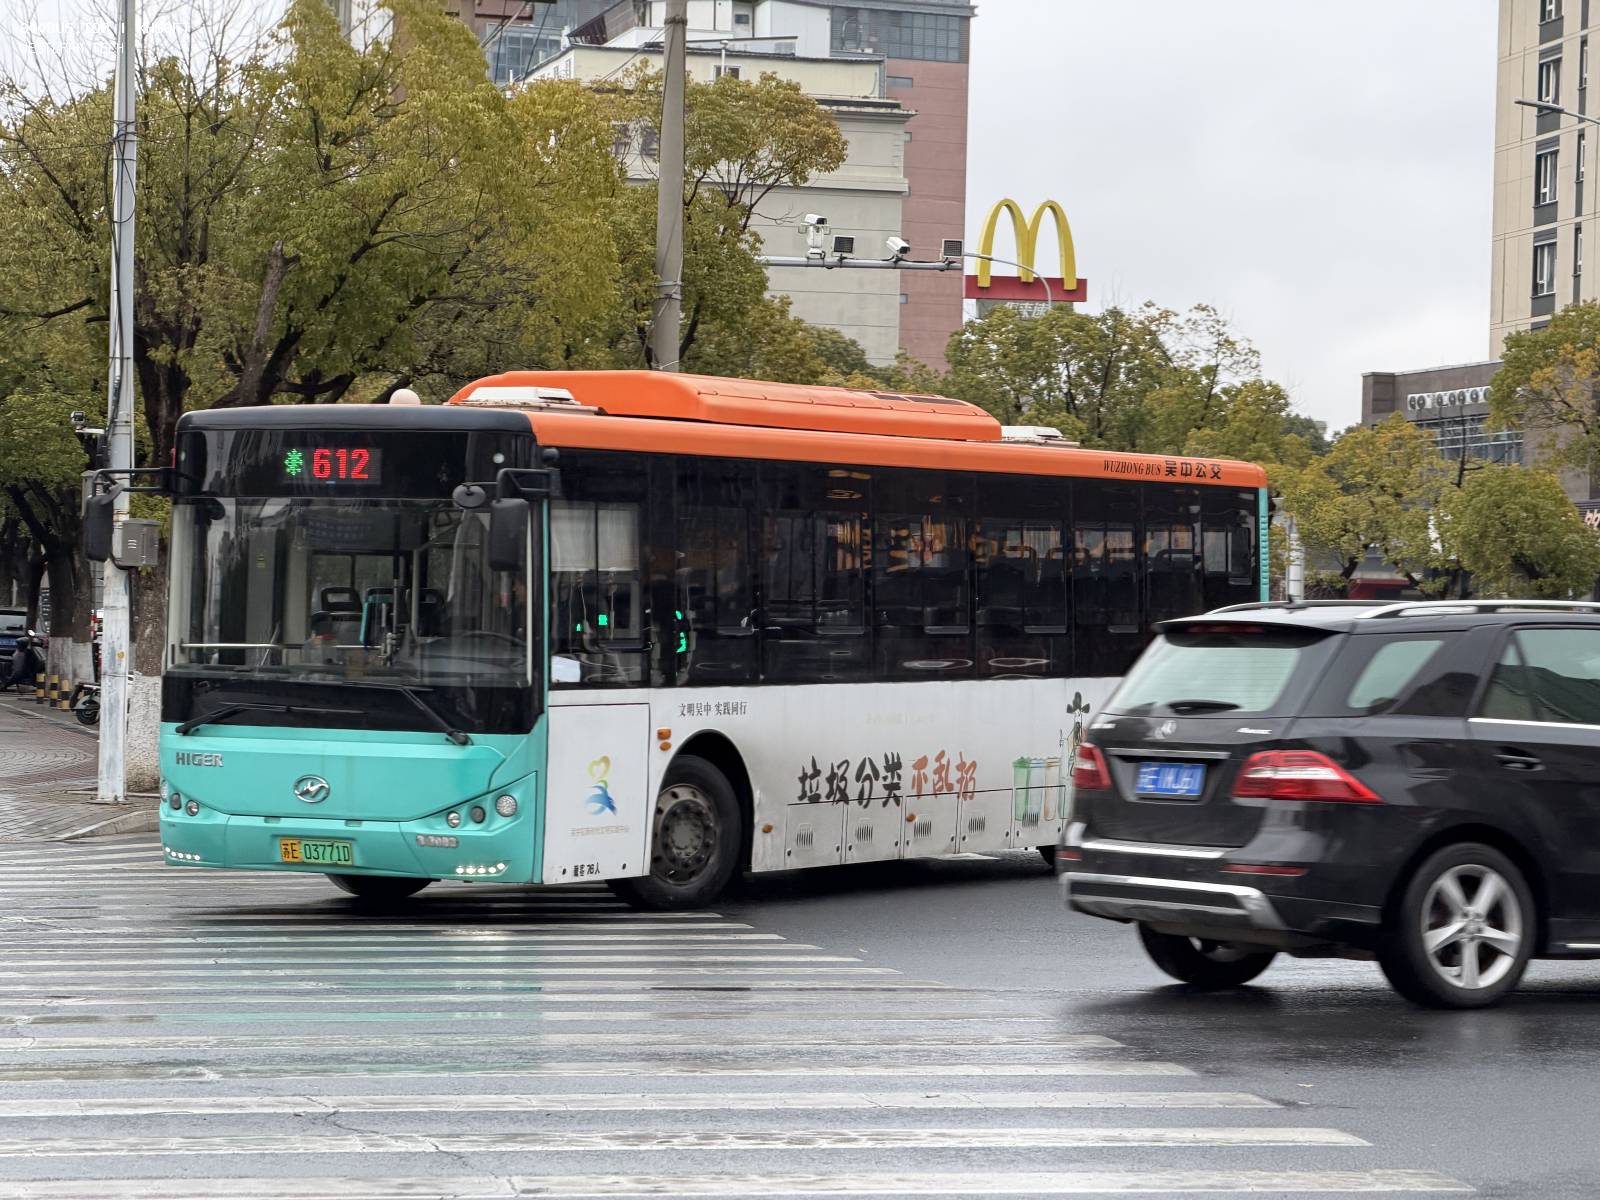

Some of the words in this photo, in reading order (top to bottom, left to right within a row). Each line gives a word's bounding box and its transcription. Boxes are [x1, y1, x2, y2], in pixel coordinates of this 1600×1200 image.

[313, 448, 369, 479] 612
[1103, 459, 1145, 475] WUZHONG
[1145, 463, 1162, 476] BUS
[1164, 459, 1222, 479] 吴中公交
[678, 702, 712, 717] 文明吴中
[714, 701, 748, 716] 实践同行
[175, 751, 224, 768] HIGER
[797, 752, 903, 809] 垃圾分类
[911, 749, 977, 801] 不乱扔
